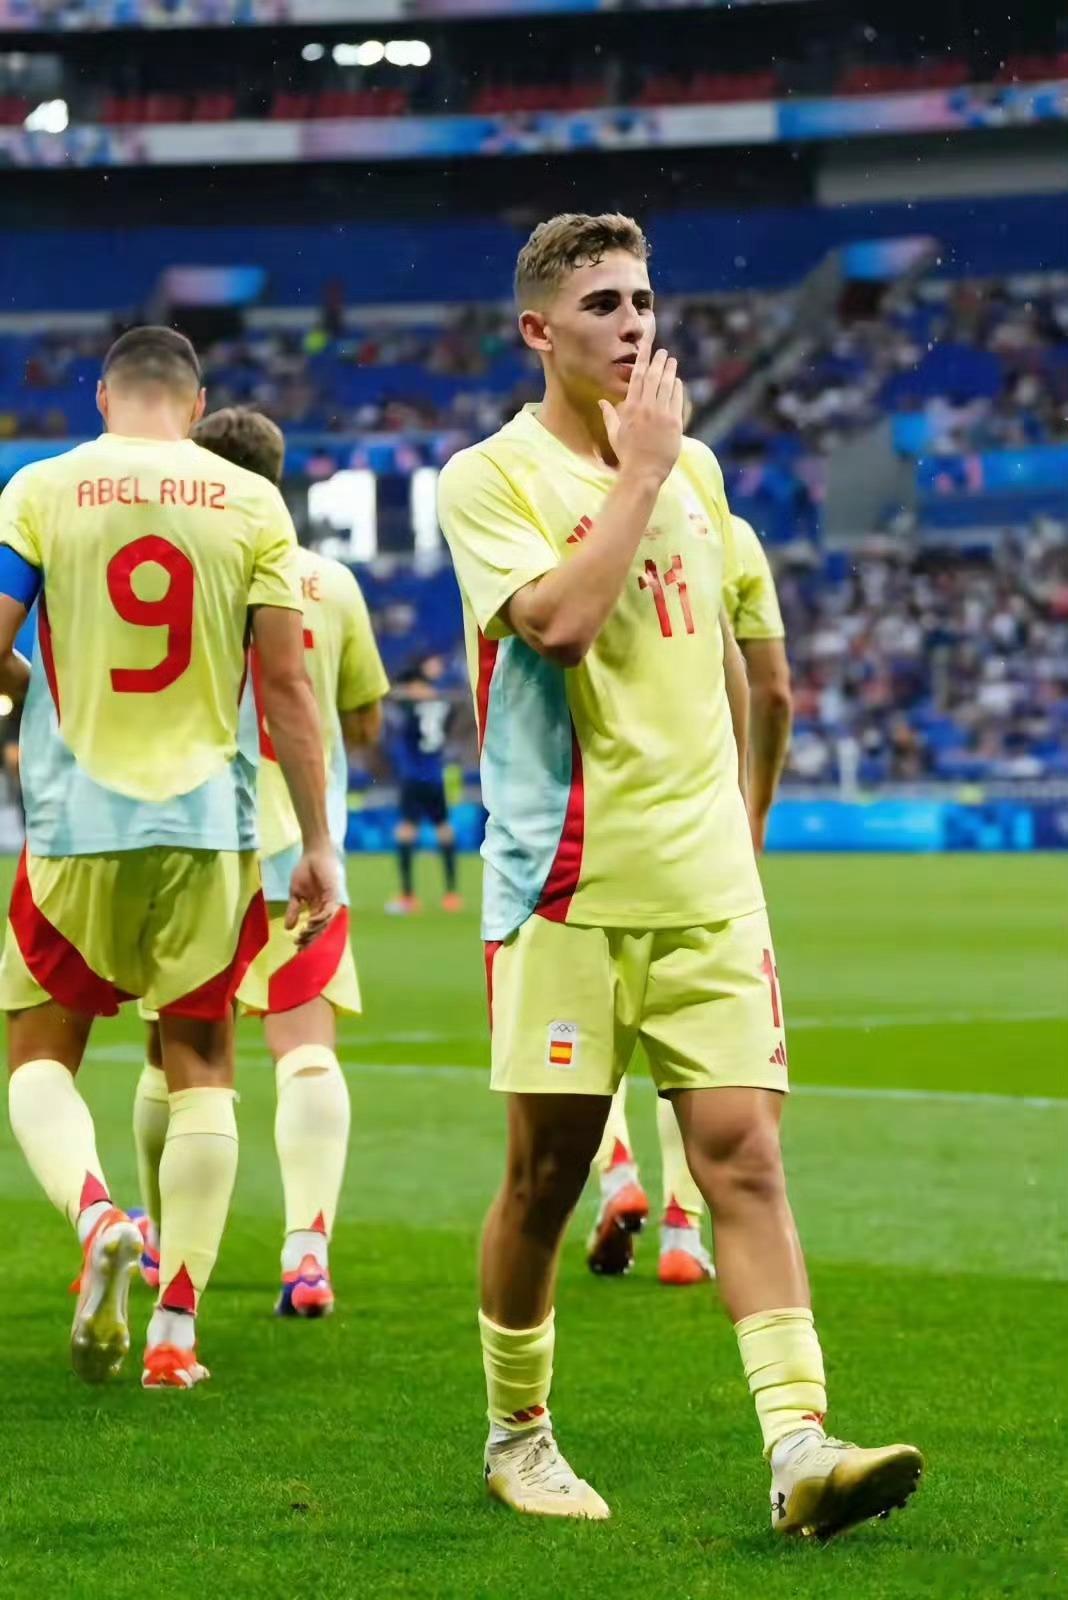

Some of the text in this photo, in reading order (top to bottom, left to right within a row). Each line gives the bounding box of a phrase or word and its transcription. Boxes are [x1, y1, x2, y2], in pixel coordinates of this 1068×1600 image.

[78, 477, 226, 510] ABEL RUIZ
[107, 534, 194, 693] 9
[638, 555, 695, 638] 11
